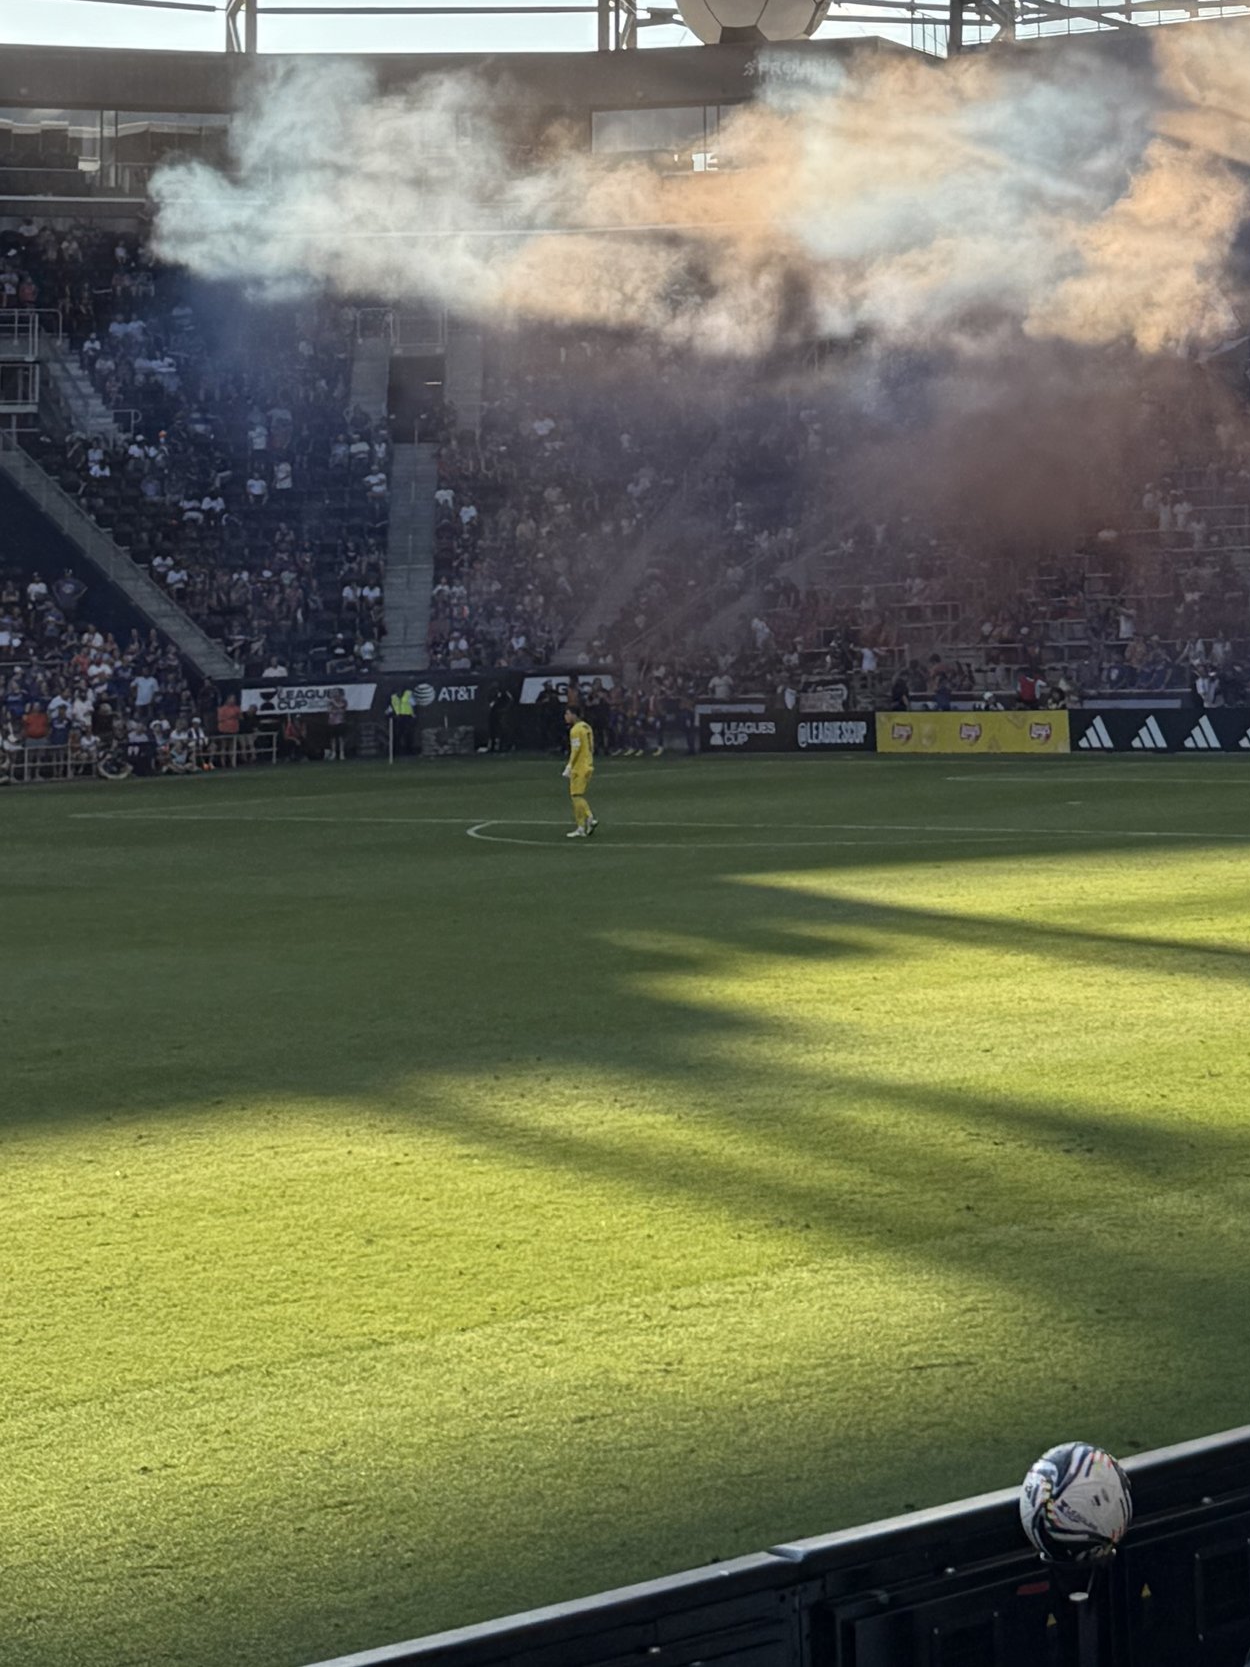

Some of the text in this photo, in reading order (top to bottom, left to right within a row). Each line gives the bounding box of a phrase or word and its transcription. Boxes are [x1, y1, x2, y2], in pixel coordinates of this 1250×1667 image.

[276, 688, 334, 701] LEAGUE
[437, 684, 478, 702] AT&T
[277, 700, 308, 711] CUP
[724, 721, 776, 735] LEAGUES
[797, 720, 868, 748] @LEAGUESCUP
[724, 734, 749, 746] CUP
